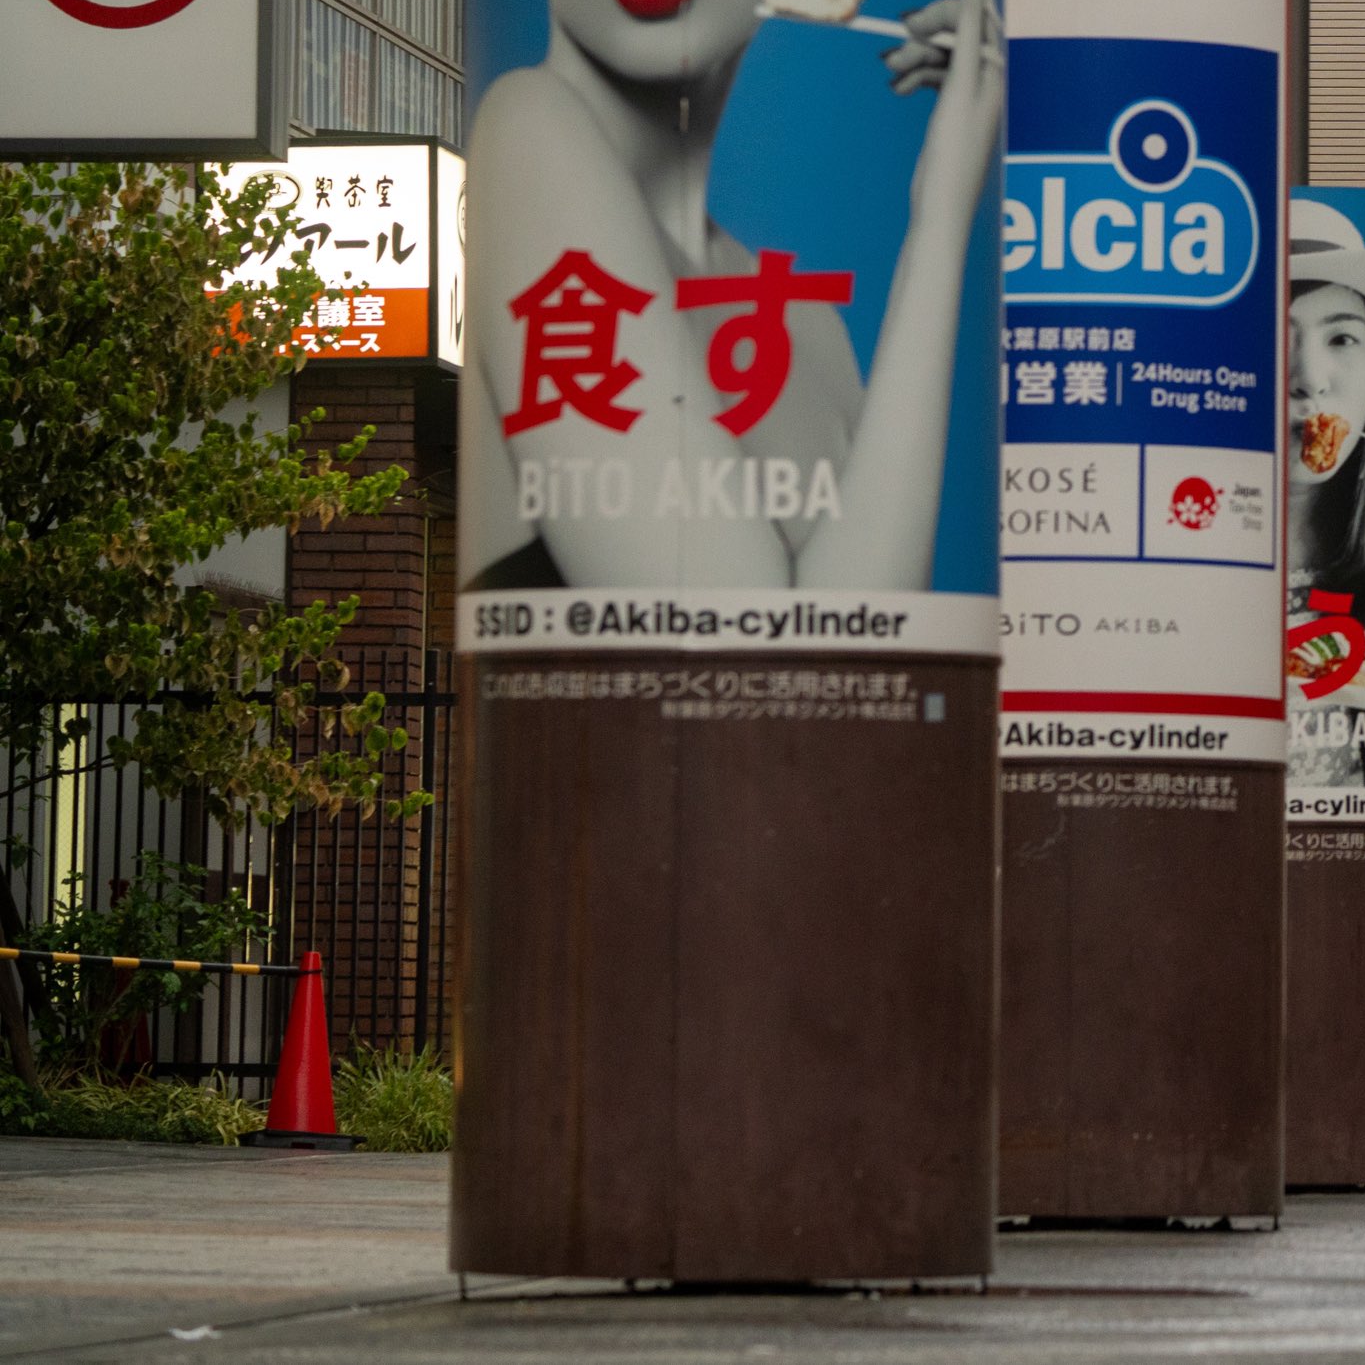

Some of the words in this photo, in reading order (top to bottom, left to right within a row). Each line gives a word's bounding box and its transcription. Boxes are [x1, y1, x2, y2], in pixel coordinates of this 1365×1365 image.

[305, 175, 394, 209] 喫茶室
[503, 246, 857, 440] 食す
[1001, 360, 1108, 406] 営業
[1131, 361, 1212, 386] 24Hours
[1215, 366, 1257, 390] Open
[1150, 387, 1200, 415] Drug
[1204, 390, 1248, 413] Store
[518, 456, 632, 521] BiTO
[659, 456, 844, 522] AKIBA
[1005, 462, 1099, 494] KOSÉ
[474, 601, 534, 639] SSID
[566, 599, 908, 640] @Akiba-cylinder
[1096, 617, 1180, 635] AKIBA
[1004, 721, 1229, 752] Akiba-cylinder
